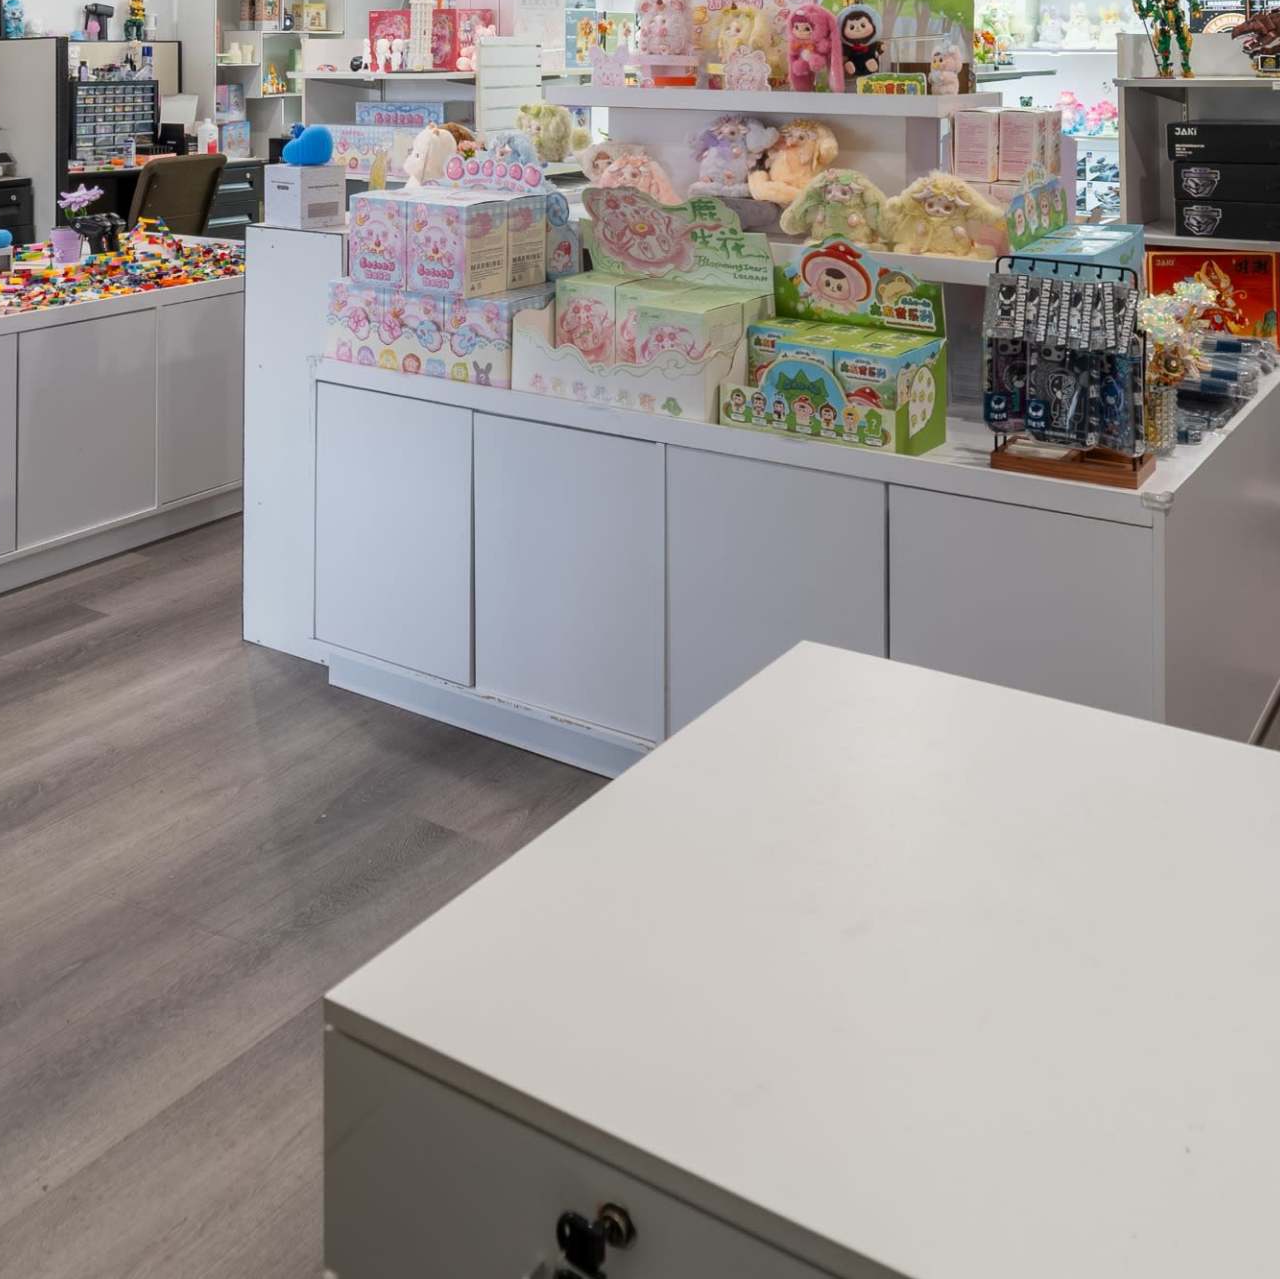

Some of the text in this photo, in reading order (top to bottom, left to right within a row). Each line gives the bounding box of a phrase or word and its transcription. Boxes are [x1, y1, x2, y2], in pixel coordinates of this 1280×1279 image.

[1014, 275, 1029, 338] IKARIKUMA
[1035, 279, 1053, 342] IKARIKUMA
[1057, 281, 1073, 346] IKARIKUMA
[1079, 284, 1095, 349] IKARIKUMA
[1103, 282, 1116, 349] IKARIKUMA
